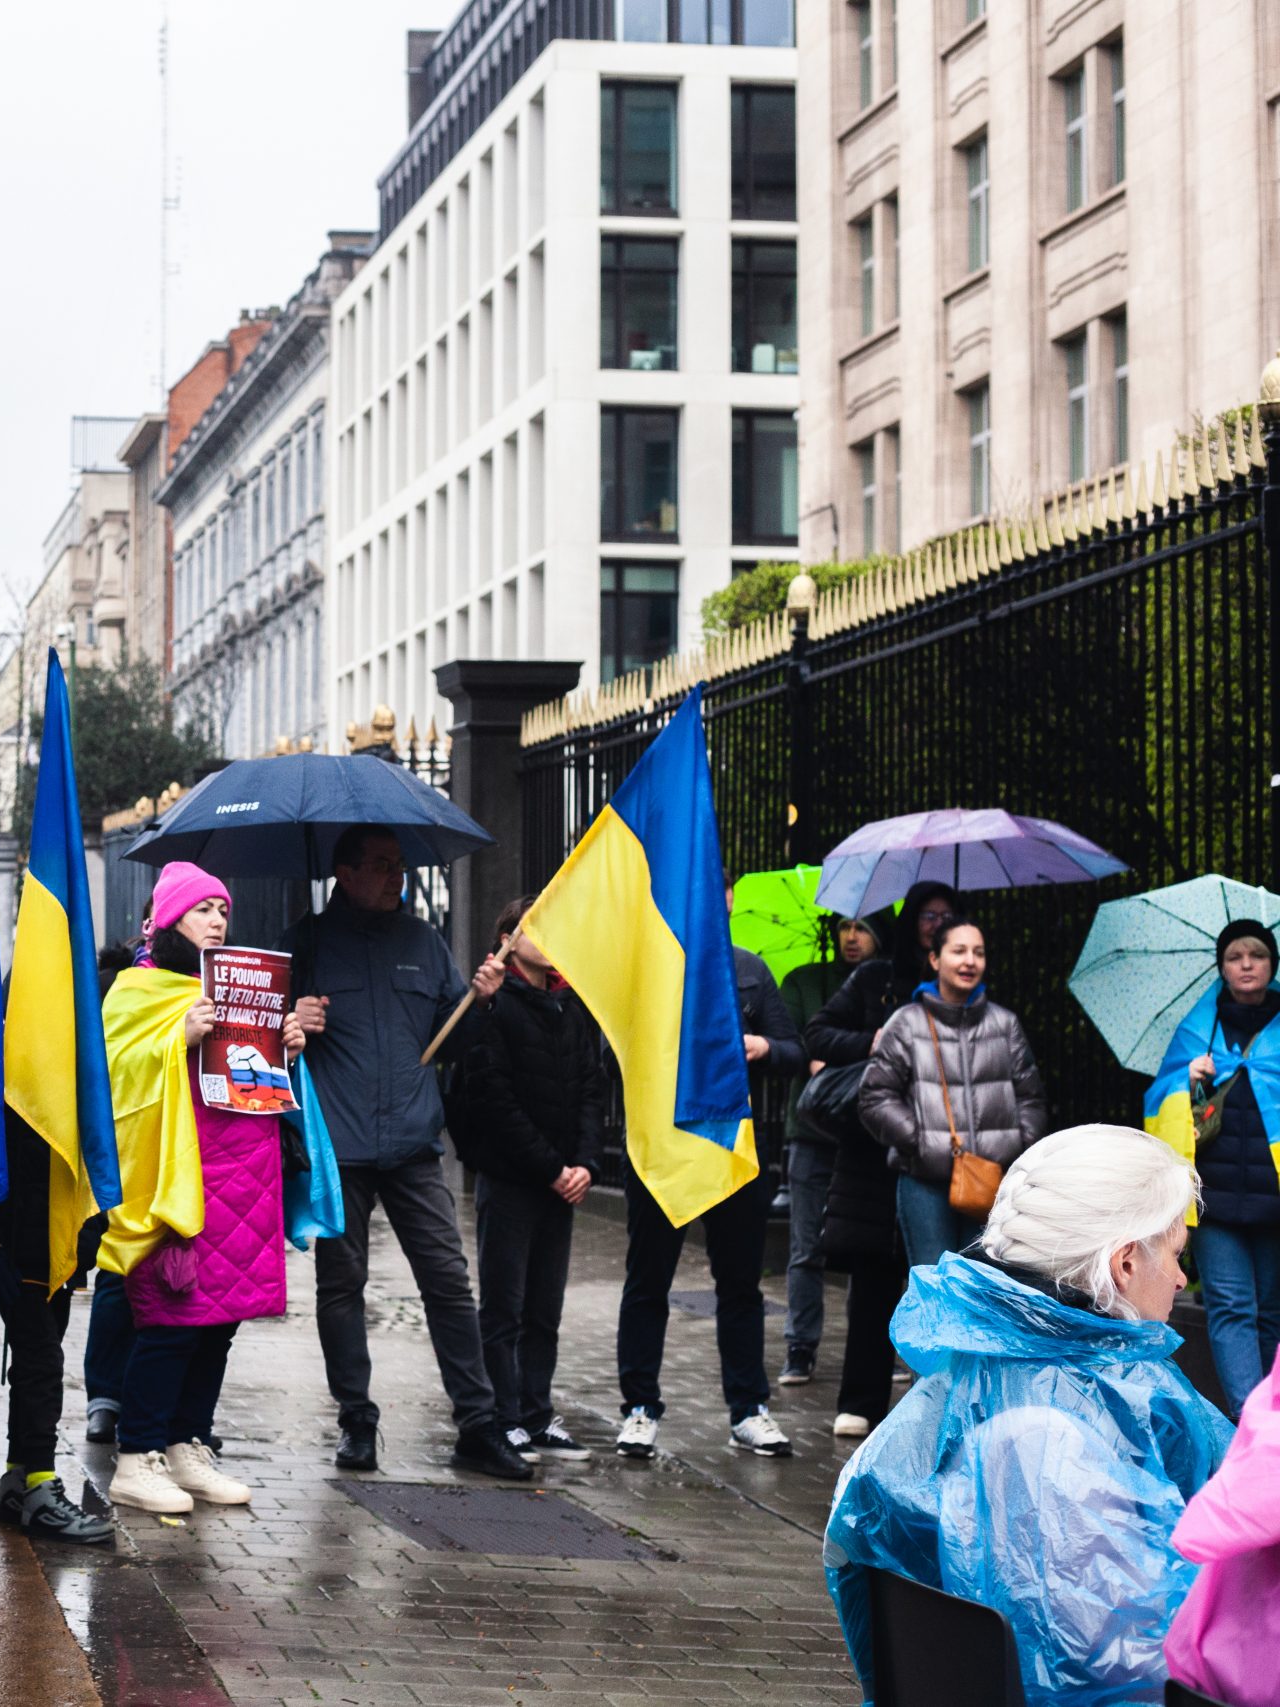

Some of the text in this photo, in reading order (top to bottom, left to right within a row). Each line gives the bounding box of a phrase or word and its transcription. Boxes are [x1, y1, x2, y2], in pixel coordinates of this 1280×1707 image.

[215, 801, 260, 815] INESIS
[214, 965, 272, 989] LE POUVOIR
[214, 985, 285, 1010] DE VETO ENTRE
[214, 1005, 284, 1030] ES MAINS D'UN
